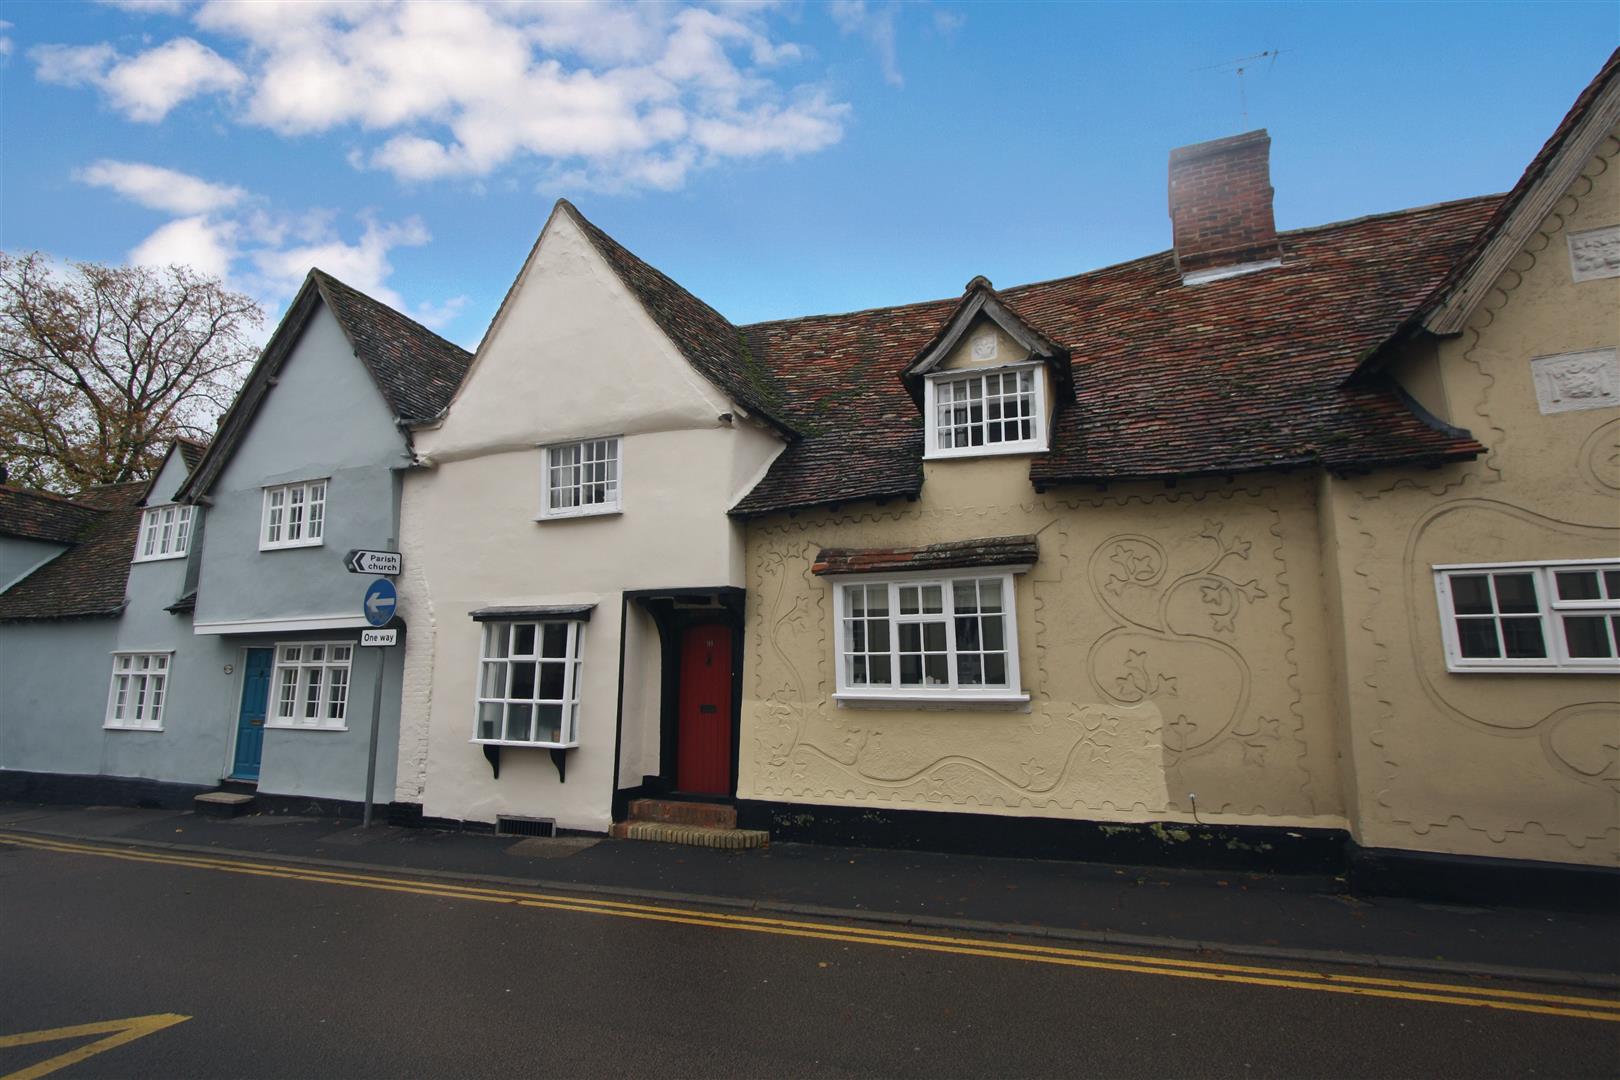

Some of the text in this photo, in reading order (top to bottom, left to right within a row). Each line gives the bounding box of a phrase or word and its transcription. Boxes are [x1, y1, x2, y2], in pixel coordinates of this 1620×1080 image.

[370, 554, 397, 563] Parish
[368, 563, 397, 571] church
[364, 633, 394, 642] One way
